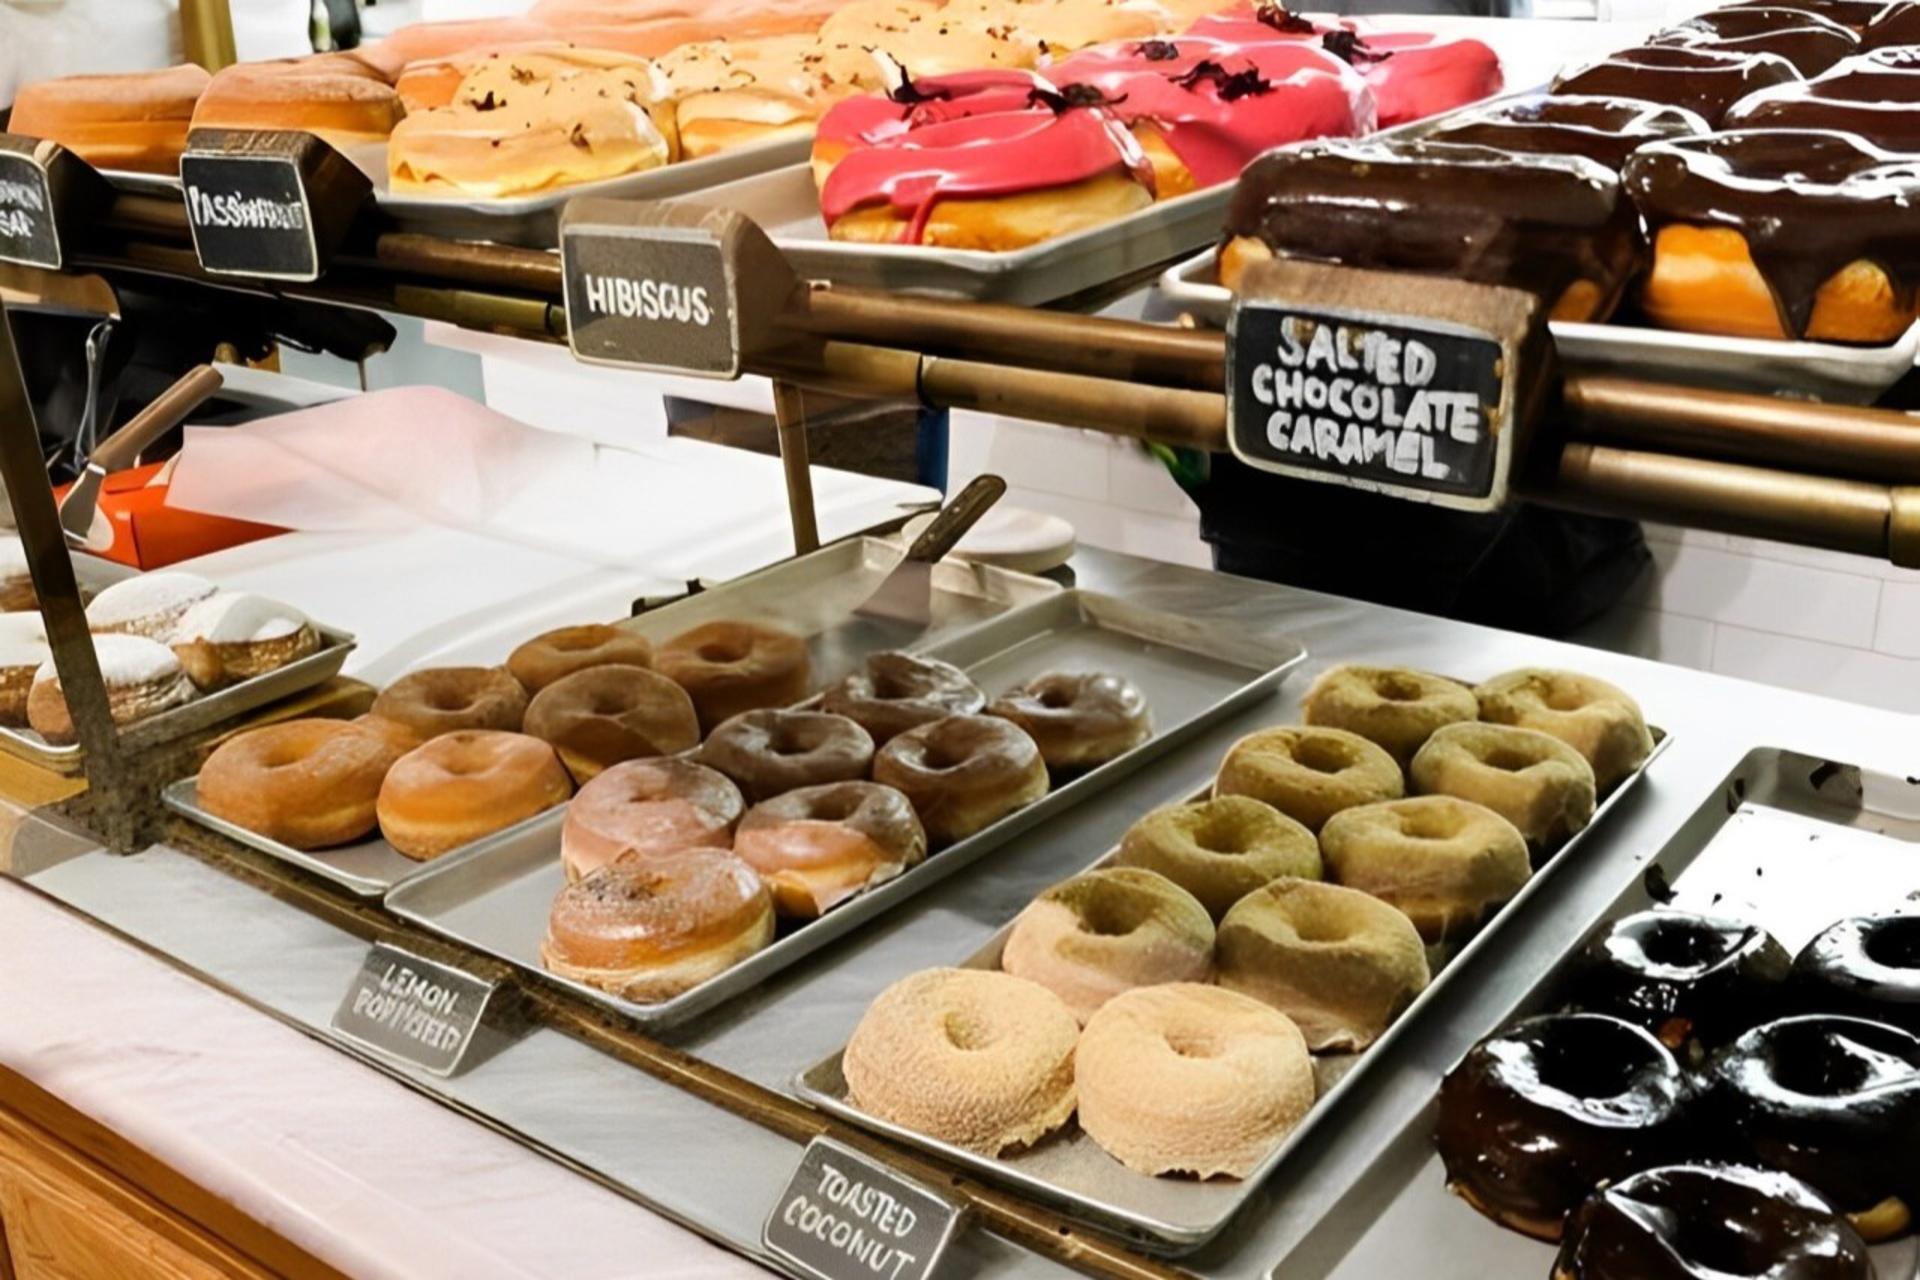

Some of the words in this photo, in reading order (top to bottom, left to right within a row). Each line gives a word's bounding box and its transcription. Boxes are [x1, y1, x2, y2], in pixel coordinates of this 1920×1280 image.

[585, 273, 711, 327] HIBISCUS
[1277, 316, 1437, 387] SALTED
[1252, 363, 1480, 444] CHOCOLATE
[1266, 411, 1450, 480] CARAMEL
[380, 963, 459, 1015] LEMON
[817, 1163, 917, 1237] TOASTED
[783, 1195, 916, 1280] COCONUT
